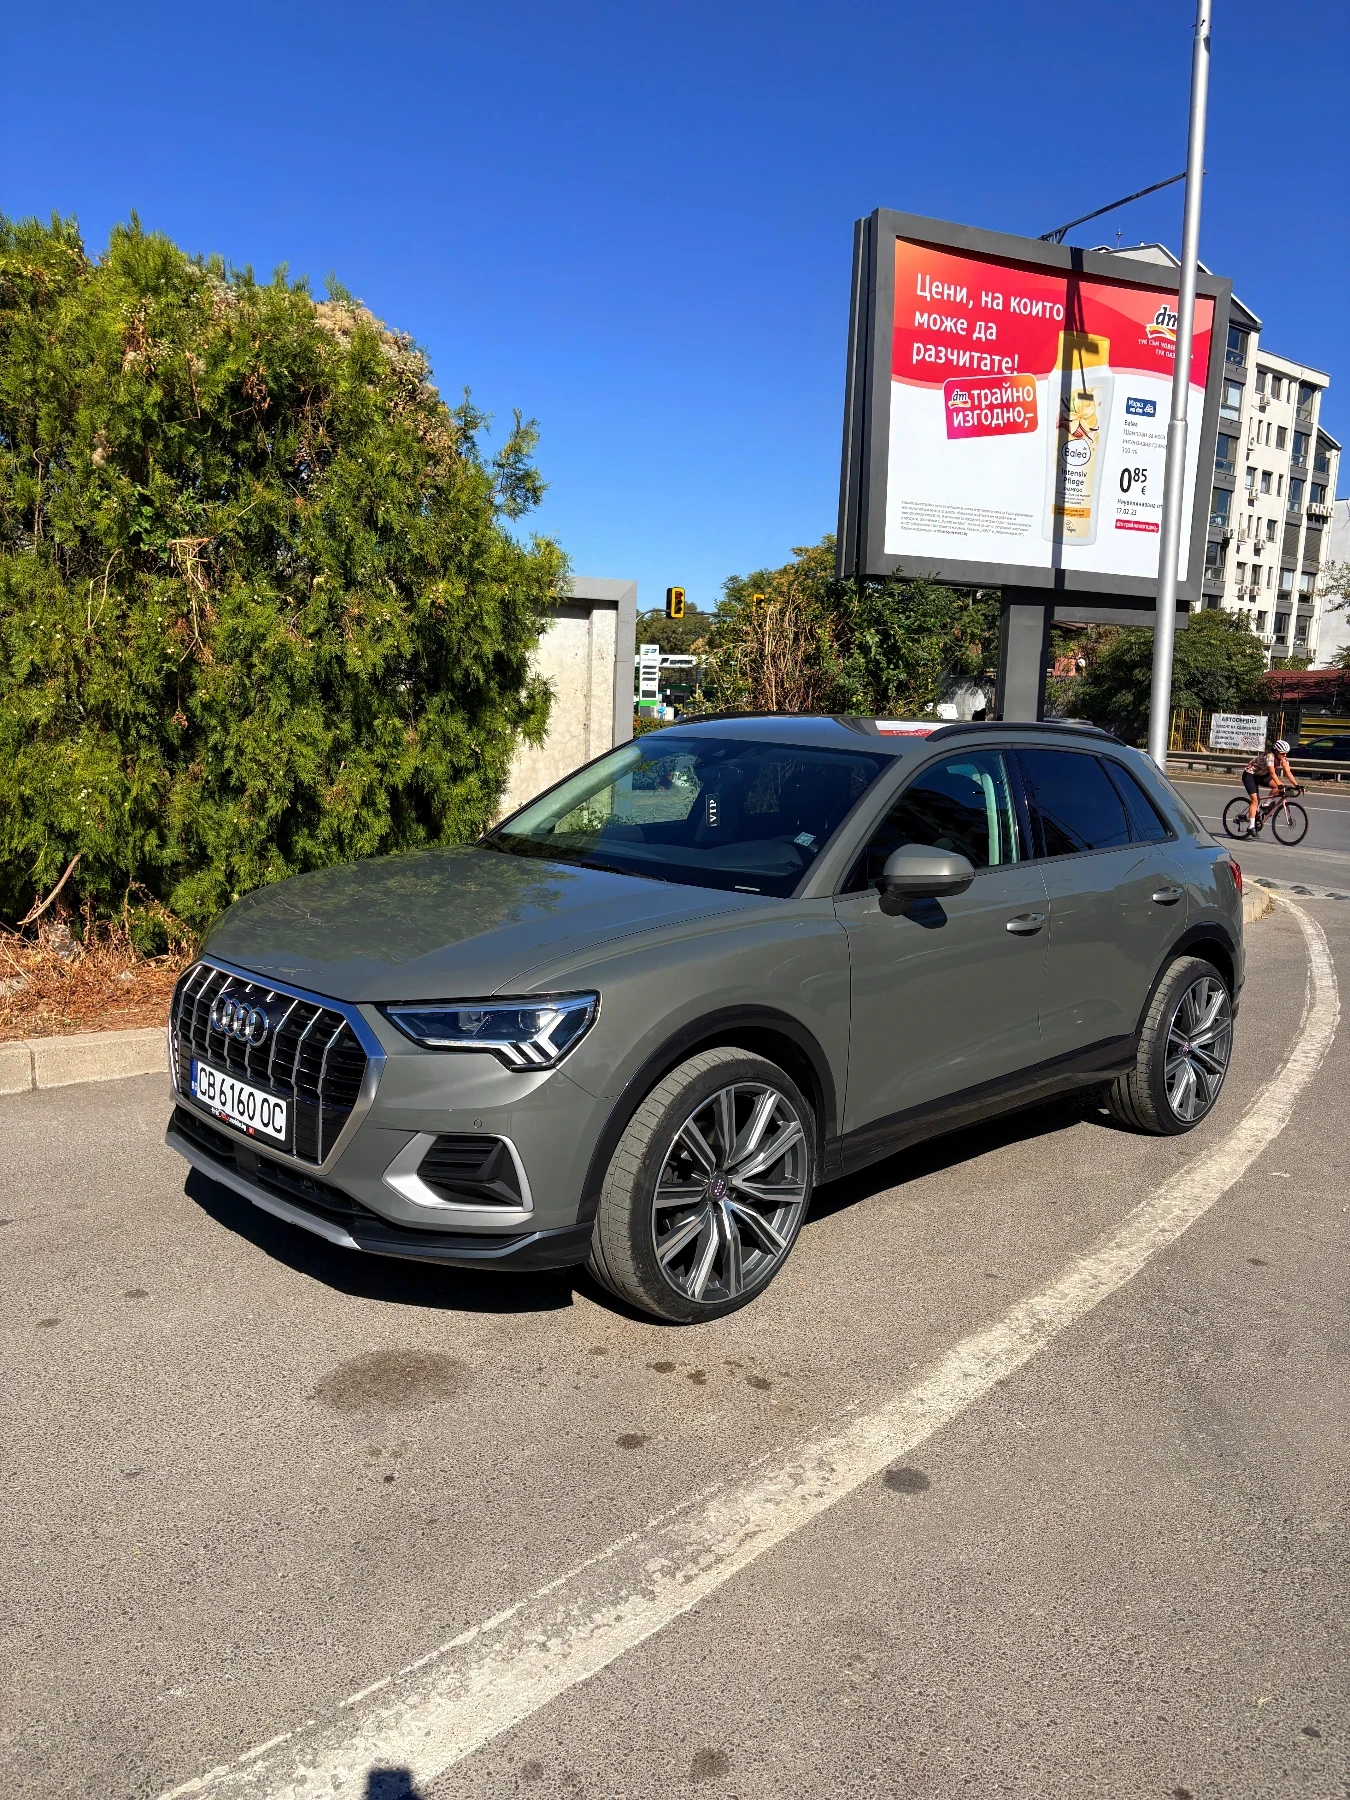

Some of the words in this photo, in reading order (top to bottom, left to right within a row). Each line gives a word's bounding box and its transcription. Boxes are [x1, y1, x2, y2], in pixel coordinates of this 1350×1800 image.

[916, 273, 974, 309] Цени,
[981, 290, 1003, 310] на
[1010, 295, 1064, 321] които
[914, 310, 968, 335] може
[972, 321, 997, 342] да
[912, 342, 1019, 375] разчитате!
[952, 390, 967, 402] dm
[971, 382, 1034, 408] трайно
[709, 799, 717, 823] VIP
[199, 1066, 216, 1101] CB
[219, 1077, 257, 1122] 6160
[260, 1097, 284, 1134] OC
